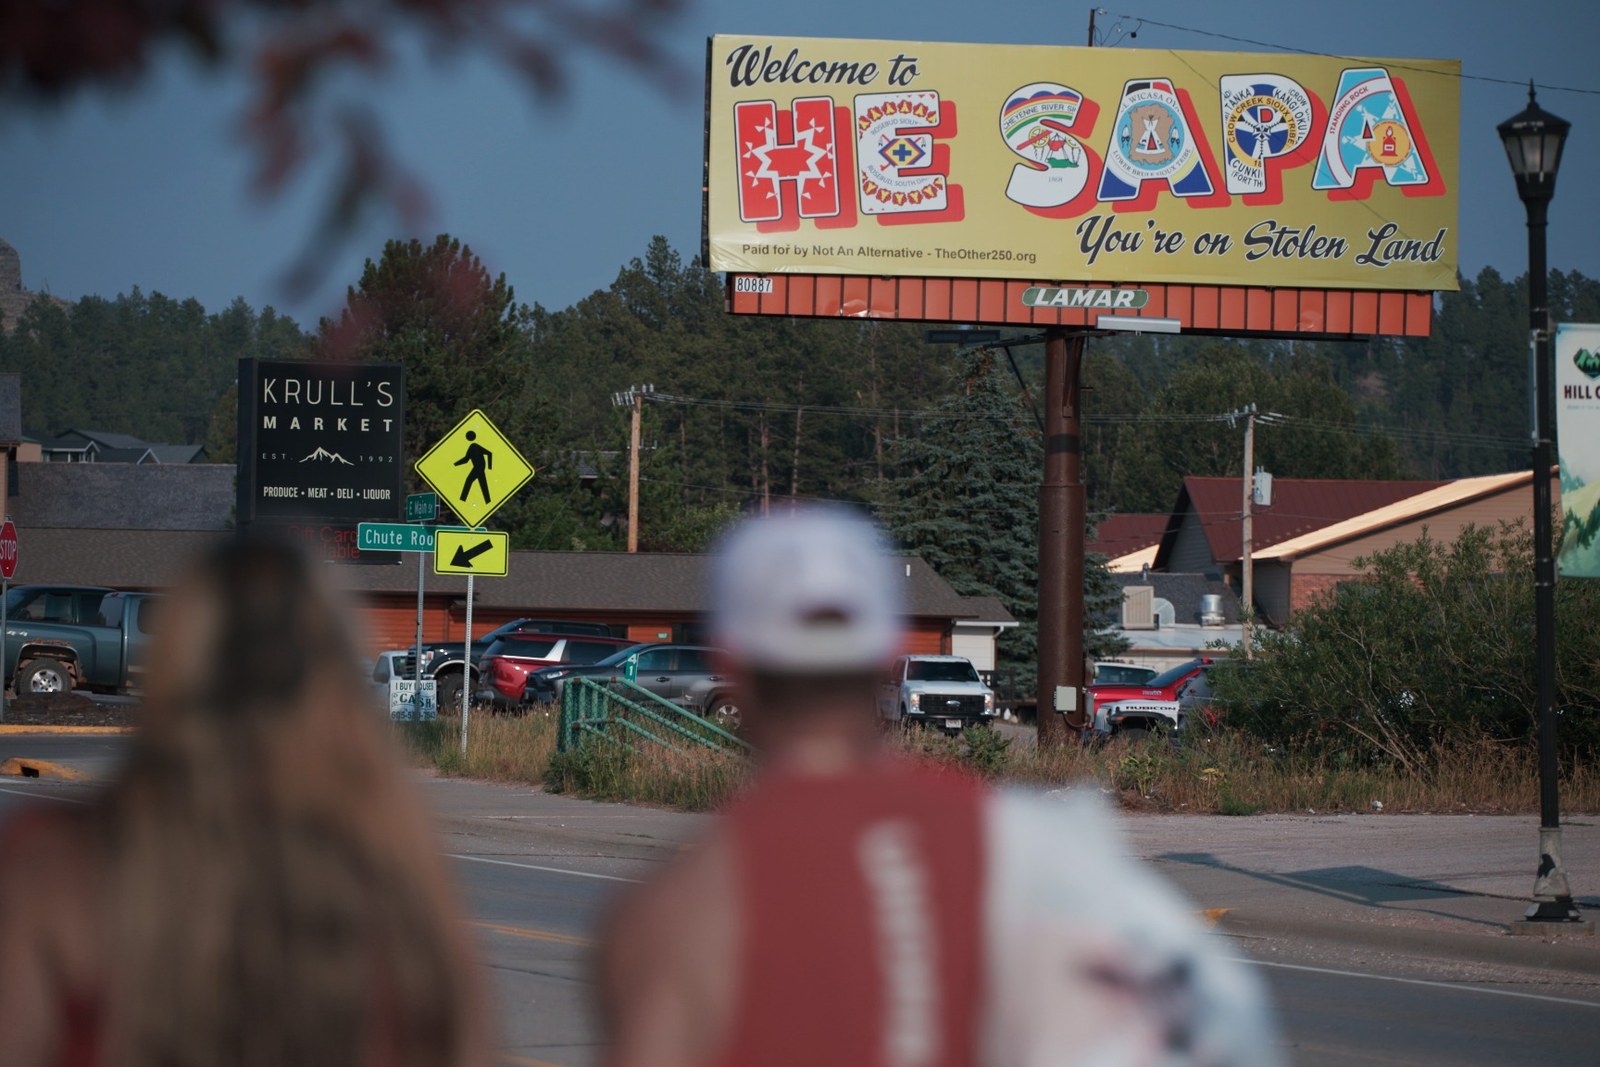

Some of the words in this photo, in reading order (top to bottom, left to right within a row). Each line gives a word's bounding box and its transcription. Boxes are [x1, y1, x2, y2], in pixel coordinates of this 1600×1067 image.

[725, 43, 880, 88] Welcome
[886, 53, 921, 87] to
[1003, 105, 1039, 131] CHEYENNE
[1041, 103, 1065, 111] RIVER
[1329, 100, 1351, 135] STANDING
[1349, 85, 1369, 101] ROCK
[1227, 114, 1238, 143] CROW
[1235, 96, 1264, 114] CREEK
[1266, 97, 1291, 117] SIOUX
[1286, 116, 1297, 146] TRIBE
[733, 89, 949, 223] HE
[998, 66, 1432, 207] SAPA
[1075, 213, 1185, 266] You're
[1193, 231, 1234, 256] on
[1243, 219, 1349, 262] Stolen
[1354, 222, 1448, 267] Land
[742, 244, 770, 255] Paid
[773, 244, 791, 256] for
[794, 244, 809, 258] by
[812, 245, 834, 256] Not
[837, 246, 854, 257] An
[857, 246, 923, 259] Alternative
[935, 248, 1037, 264] TheOther250.org
[737, 278, 772, 293] 80887
[1034, 287, 1136, 308] LAMAR
[263, 377, 394, 408] KRULL'S
[1564, 385, 1593, 400] HILL
[263, 415, 394, 433] MARKET
[359, 455, 394, 464] 1992
[263, 486, 299, 499] PRODUCE
[307, 487, 329, 499] MEAT
[337, 488, 355, 500] DELI
[363, 489, 391, 500] LIQUOR
[414, 499, 428, 516] Main
[365, 529, 403, 546] Chute
[410, 530, 434, 547] Roo
[0, 540, 17, 561] STOP
[399, 682, 413, 691] BUY
[399, 693, 432, 708] CASH
